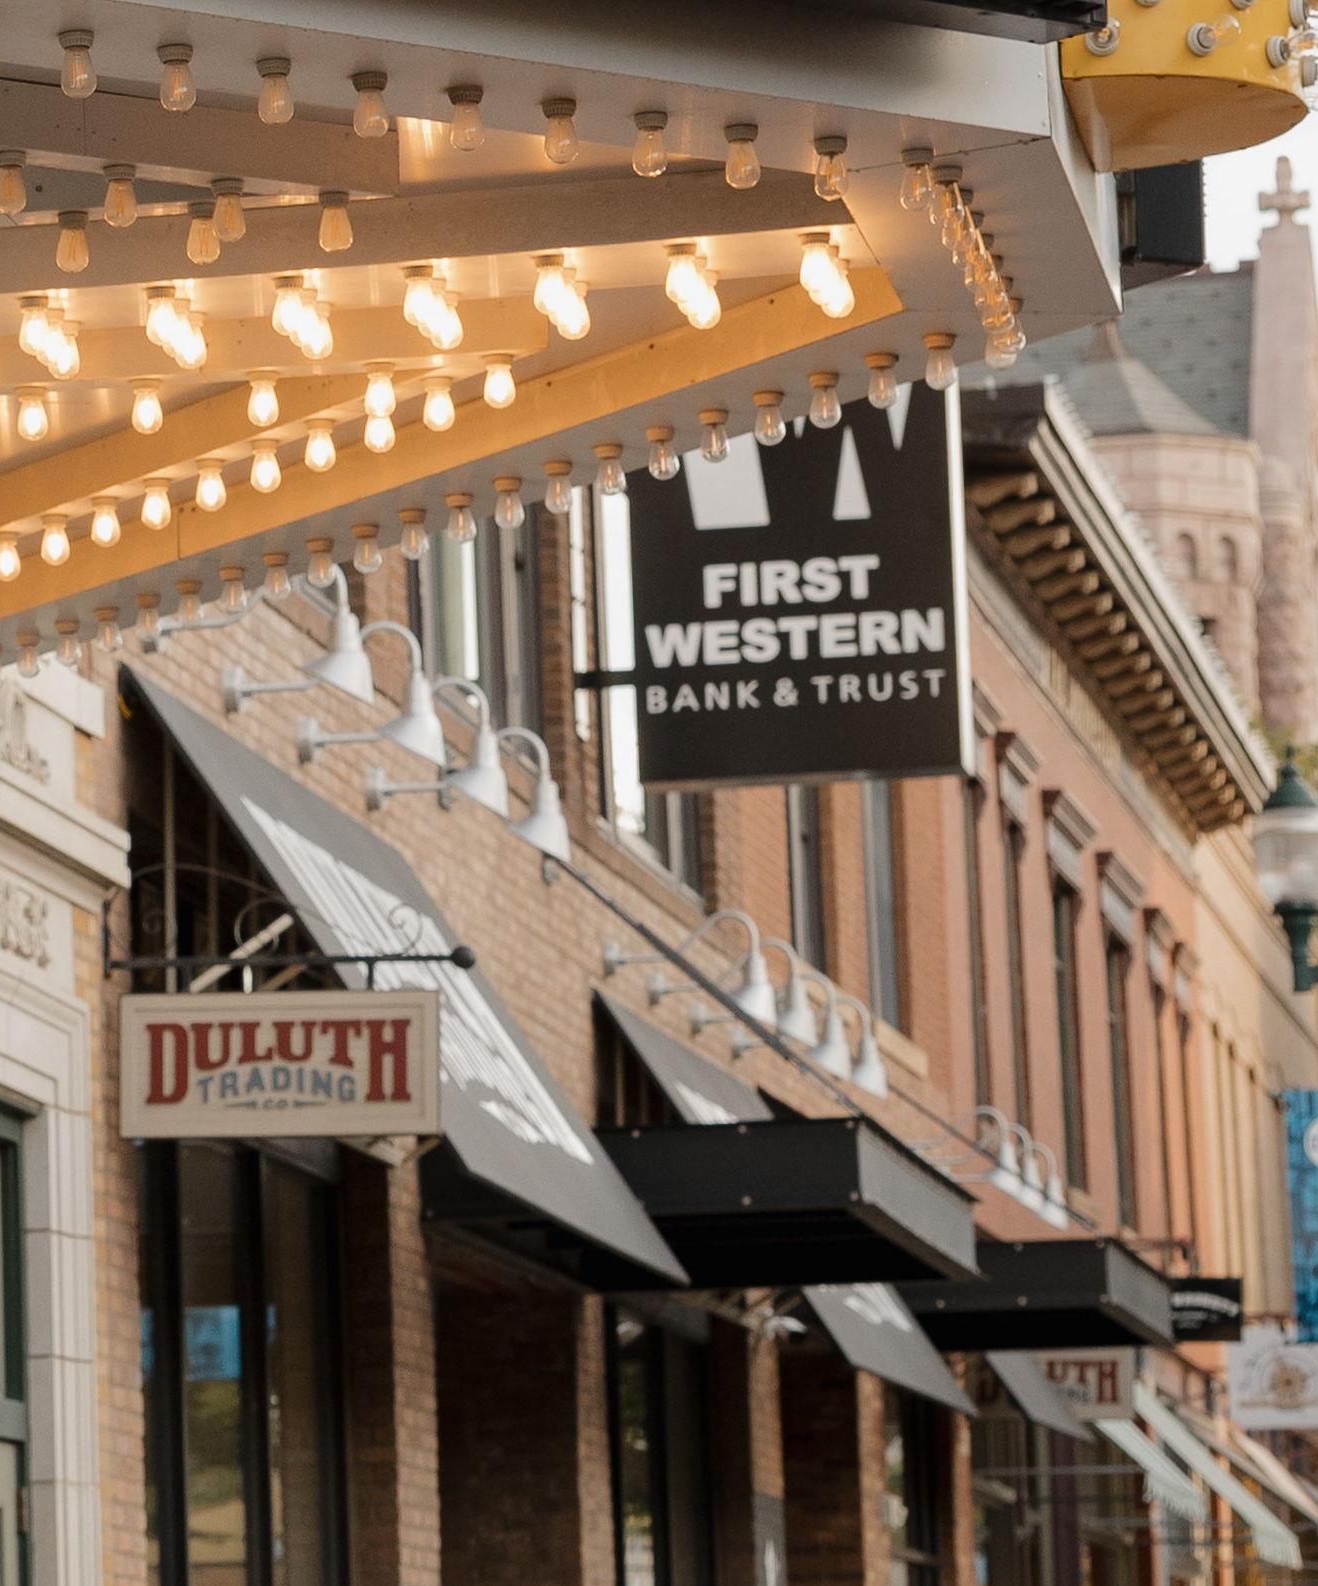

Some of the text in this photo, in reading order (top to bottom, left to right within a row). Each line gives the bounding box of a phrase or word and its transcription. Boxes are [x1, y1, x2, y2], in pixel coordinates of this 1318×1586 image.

[702, 555, 880, 609] FIRST
[645, 607, 946, 668] WESTERN
[645, 669, 947, 714] BANK & TRUST
[145, 1018, 412, 1106] DULUTH
[196, 1066, 357, 1104] TRADING
